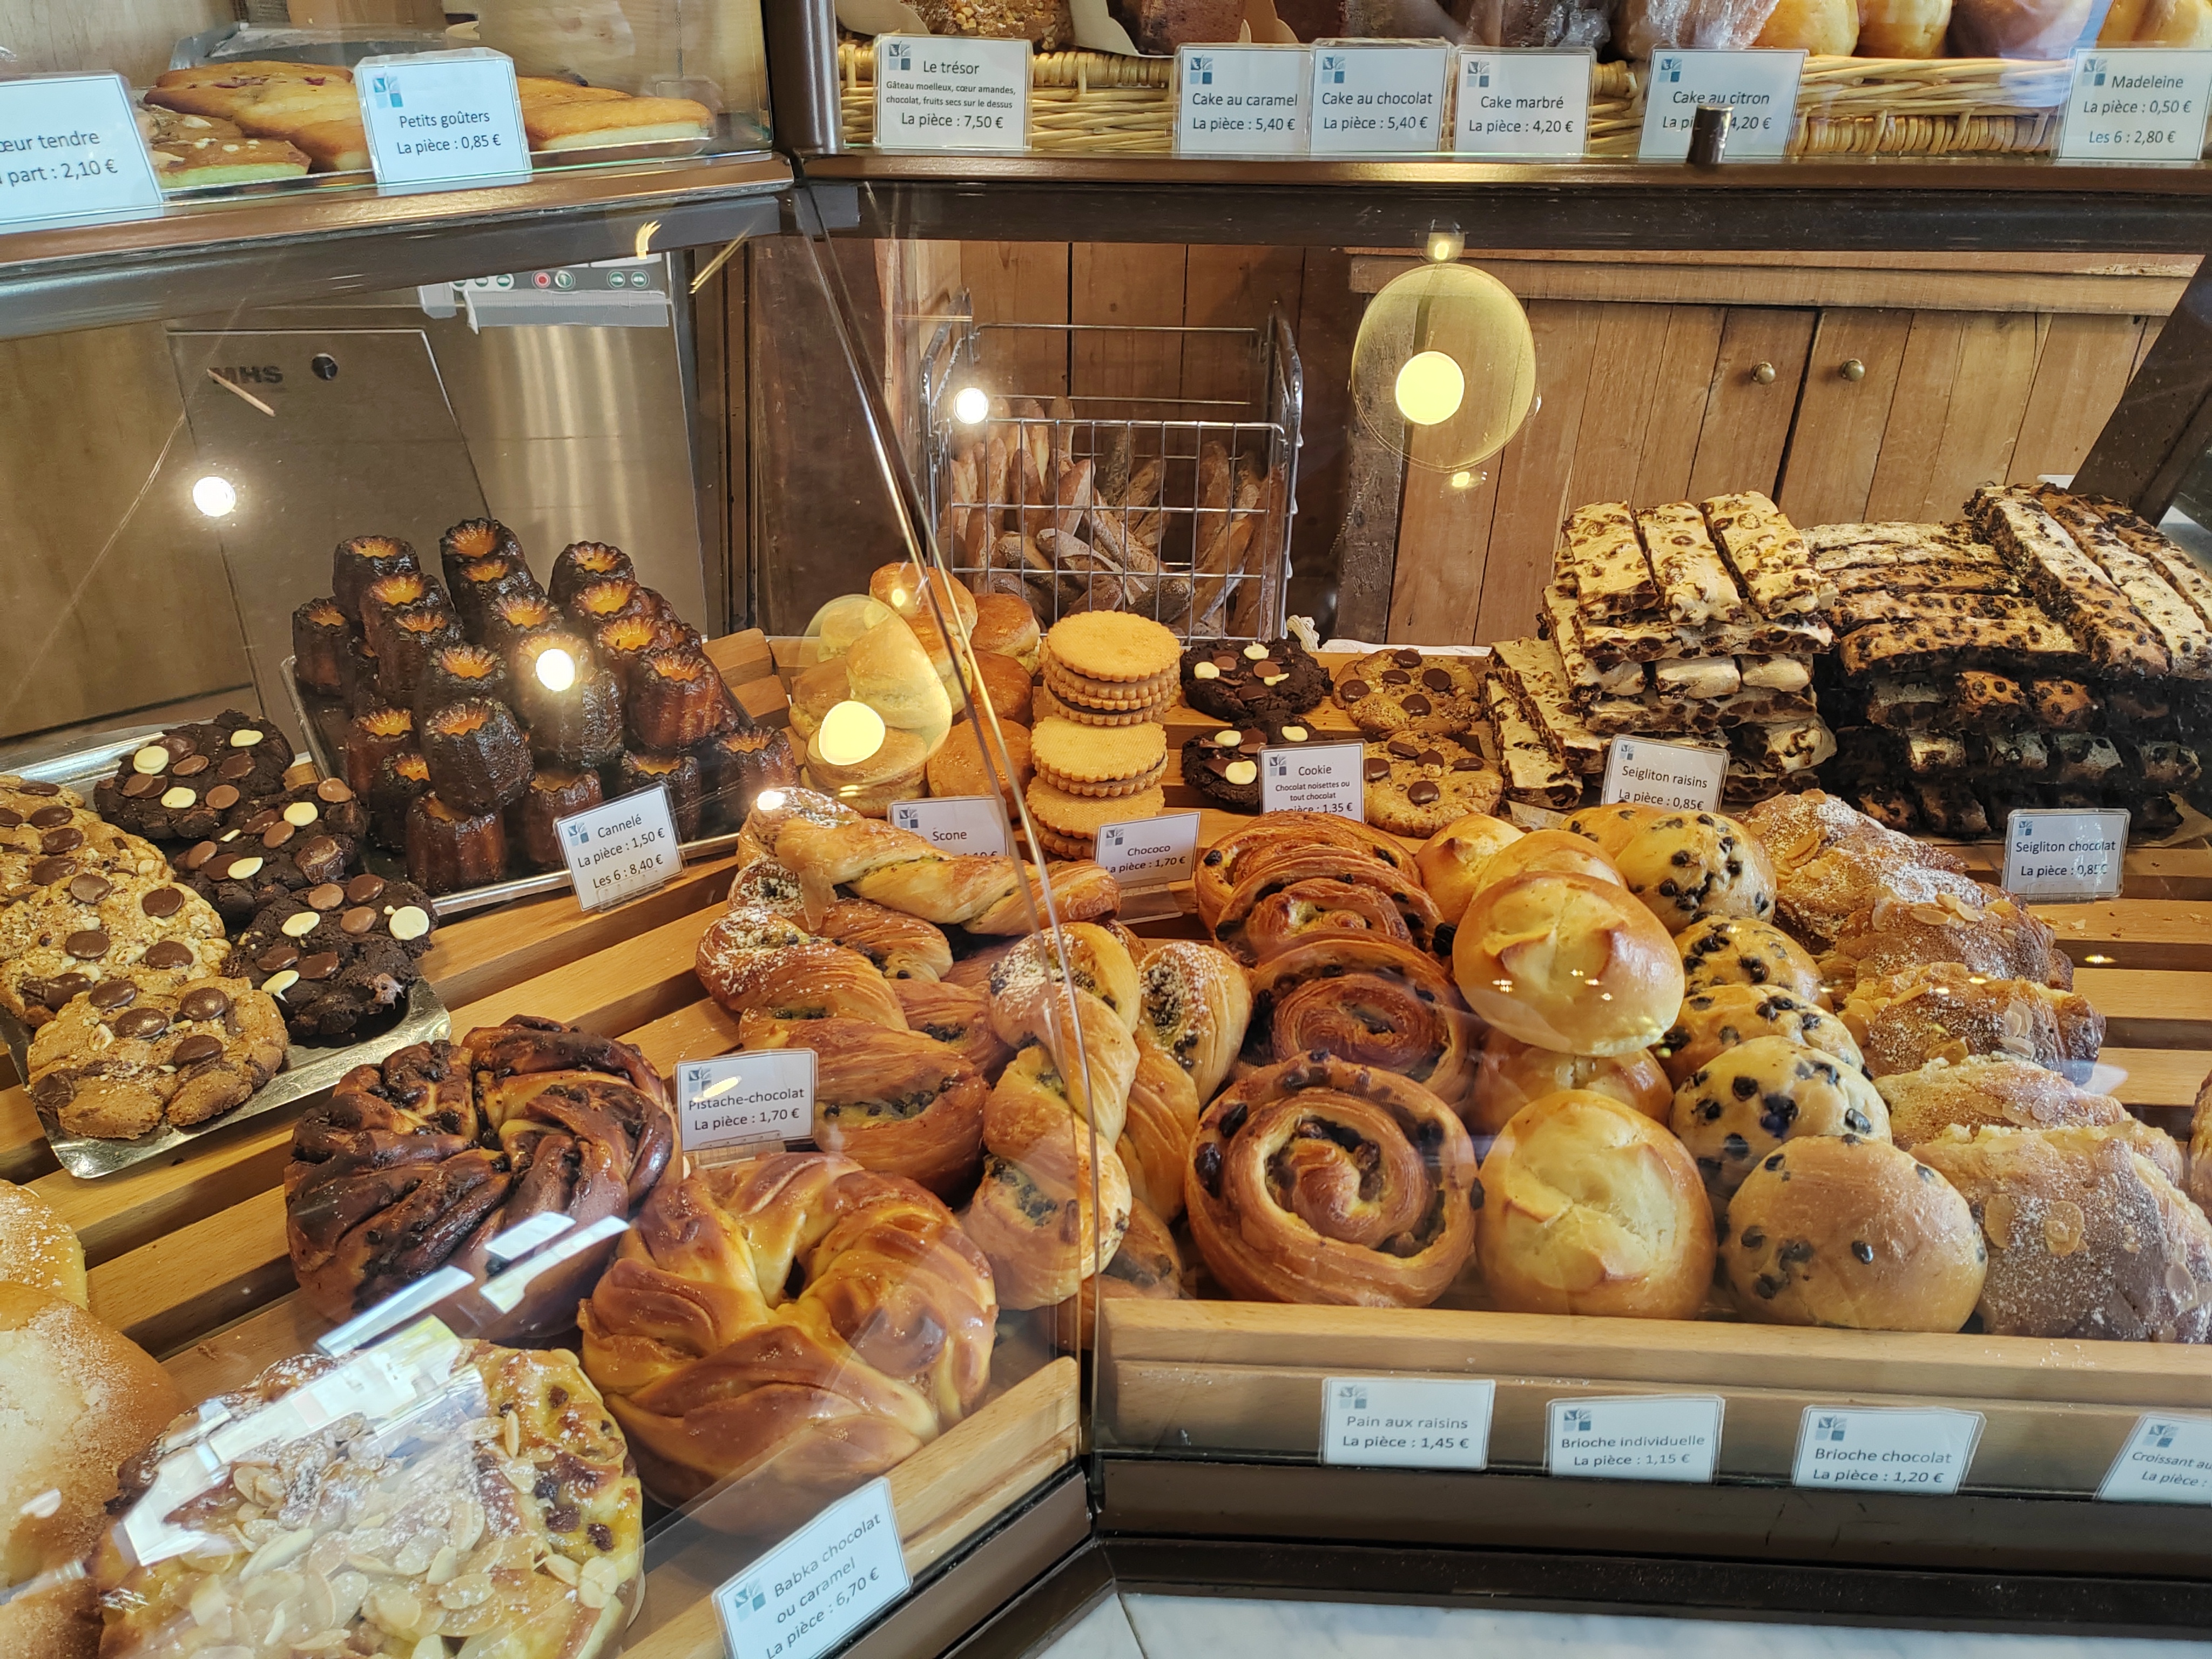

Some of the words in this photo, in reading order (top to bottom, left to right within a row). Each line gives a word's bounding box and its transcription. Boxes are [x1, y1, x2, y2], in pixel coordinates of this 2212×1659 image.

[923, 60, 937, 73] Le
[941, 60, 980, 75] trésor
[886, 81, 914, 90] Gâteau
[916, 82, 954, 92] moelleux,
[979, 86, 1016, 95] amandes,
[2112, 76, 2183, 88] Madeleine
[886, 96, 921, 105] chocolat,
[923, 97, 943, 105] fruits
[987, 100, 1013, 109] dessus
[1192, 92, 1223, 105] Cake
[1227, 96, 1242, 105] au
[1246, 93, 1298, 106] caramel
[1323, 92, 1353, 104] Cake
[1357, 95, 1373, 104] au
[1377, 91, 1433, 104] chocolat
[1481, 96, 1512, 108] Cake
[1516, 96, 1563, 109] marbré
[1673, 91, 1705, 104] Cake
[1709, 94, 1725, 103] au
[1730, 92, 1770, 104] citron
[2083, 101, 2097, 113] La
[2101, 99, 2137, 116] pièce
[2149, 100, 2179, 115] 0,50
[2183, 100, 2191, 113] €
[399, 114, 437, 129] Petits
[441, 111, 490, 128] goûters
[902, 112, 914, 125] La
[919, 113, 953, 127] pièce
[965, 115, 992, 129] 7,50
[996, 117, 1003, 129] €
[1193, 117, 1206, 129] La
[1211, 117, 1244, 132] pièce
[1256, 118, 1283, 132] 5,40
[1287, 118, 1296, 130] €
[1324, 117, 1337, 129] La
[1341, 116, 1376, 131] pièce
[1388, 116, 1416, 131] 5,40
[1420, 117, 1428, 129] €
[1469, 119, 1482, 131] La
[1487, 119, 1521, 134] pièce
[1533, 120, 1561, 134] 4,20
[1565, 120, 1573, 132] €
[1663, 116, 1676, 128] La
[1763, 117, 1771, 129] €
[38, 131, 101, 149] tendre
[397, 141, 412, 154] La
[416, 139, 450, 156] pièce
[461, 134, 489, 151] 0,85
[493, 134, 501, 146] €
[2089, 131, 2109, 143] Les
[2114, 131, 2122, 143] 6
[2134, 131, 2163, 145] 2,80
[2167, 131, 2176, 143] €
[8, 167, 47, 187] part
[61, 160, 100, 180] 2,10
[105, 159, 118, 173] €
[1298, 765, 1332, 775] Cookie
[1622, 766, 1669, 783] Seigliton
[1673, 775, 1708, 788] raisins
[1276, 783, 1306, 791] Chocolat
[1323, 803, 1343, 813] 1,35
[1347, 802, 1353, 811] €
[1619, 789, 1630, 799] La
[1634, 792, 1663, 803] pièce
[1673, 797, 1704, 811] 0,85€
[598, 814, 642, 838] Cannelé
[933, 831, 967, 841] Scone
[578, 857, 590, 868] La
[594, 845, 623, 865] pièce
[632, 832, 655, 848] 1,50
[658, 827, 665, 838] €
[1128, 845, 1170, 856] Chococo
[2016, 841, 2065, 854] Seigliton
[2069, 841, 2115, 851] chocolat
[593, 874, 611, 888] Les
[614, 869, 621, 880] 6
[630, 858, 653, 874] 8,40
[656, 854, 663, 865] €
[1119, 862, 1145, 873] pièce
[1154, 857, 1176, 868] 1,70
[1179, 856, 1186, 864] €
[2021, 866, 2033, 875] La
[2037, 865, 2067, 878] pièce
[2077, 864, 2108, 876] 0,85€
[689, 1088, 804, 1110] Pistache-chocolat
[695, 1120, 708, 1130] La
[713, 1115, 747, 1130] pièce
[760, 1109, 787, 1123] 1,70
[791, 1108, 799, 1118] €
[1347, 1417, 1379, 1427] Pain
[1385, 1419, 1413, 1427] aux
[1418, 1418, 1468, 1428] raisins
[1343, 1436, 1359, 1446] La
[1365, 1436, 1406, 1448] pièce
[1421, 1438, 1454, 1449] 1,45
[1460, 1439, 1469, 1448] €
[1562, 1438, 1616, 1448] Brioche
[1621, 1435, 1705, 1446] individuelle
[1574, 1456, 1588, 1465] La
[1594, 1455, 1631, 1467] pièce
[1646, 1454, 1676, 1465] 1,15
[1681, 1454, 1690, 1463] €
[1815, 1448, 1877, 1461] Brioche
[1882, 1451, 1952, 1463] chocolat
[2133, 1452, 2195, 1467] Croissant
[1813, 1469, 1830, 1480] La
[1835, 1469, 1878, 1482] pièce
[1893, 1472, 1928, 1483] 1,20
[1934, 1473, 1944, 1483] €
[2142, 1471, 2157, 1481] La
[2160, 1473, 2198, 1486] pièce
[774, 1559, 819, 1597] Babka
[822, 1514, 881, 1563] chocolat
[777, 1604, 796, 1624] ou
[800, 1556, 857, 1607] caramel
[766, 1643, 783, 1659] La
[787, 1610, 825, 1647] pièce
[837, 1577, 867, 1606] 6,70
[870, 1567, 879, 1581] €
